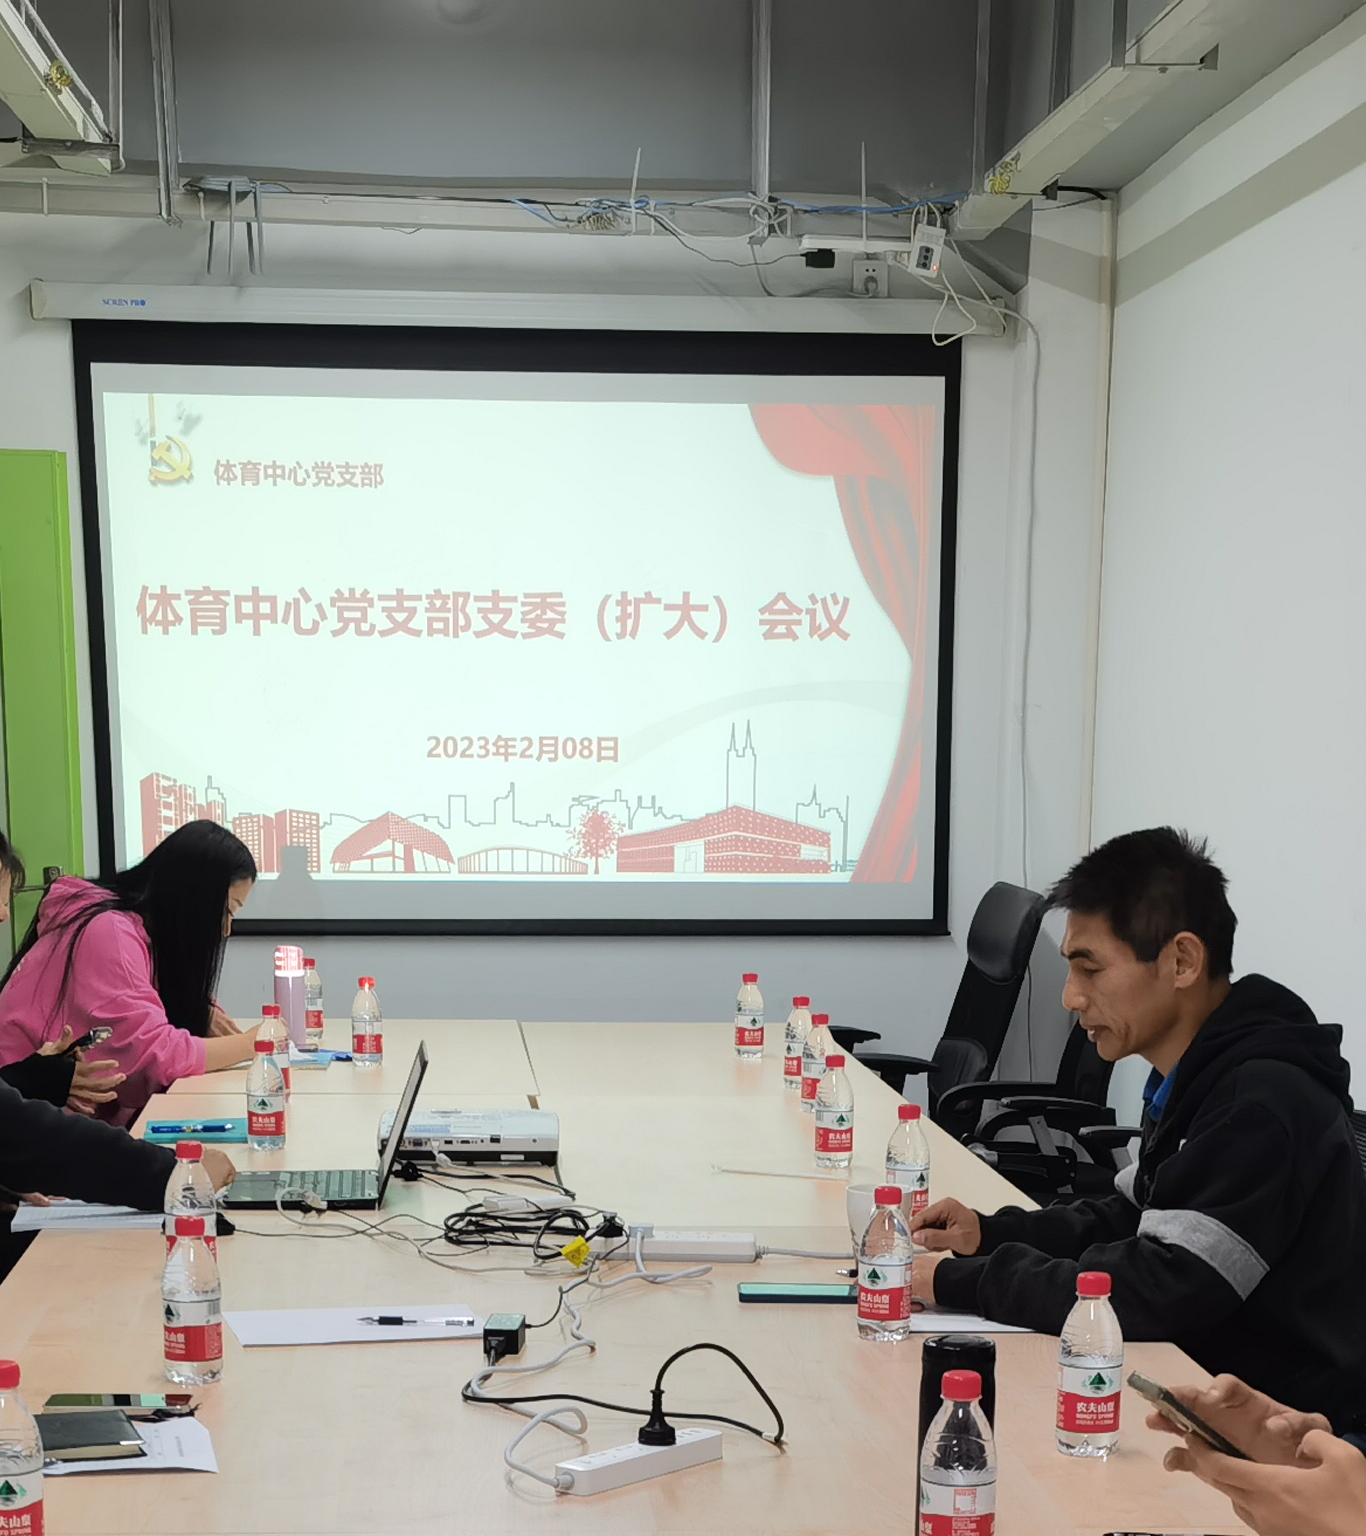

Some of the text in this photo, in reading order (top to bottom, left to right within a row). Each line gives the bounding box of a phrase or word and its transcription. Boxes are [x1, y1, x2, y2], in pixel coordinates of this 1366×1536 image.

[213, 459, 385, 488] 体育中心党支部
[136, 584, 852, 644] 体育中心党支部支委（扩大）会议
[426, 735, 621, 763] 2023年2月08日
